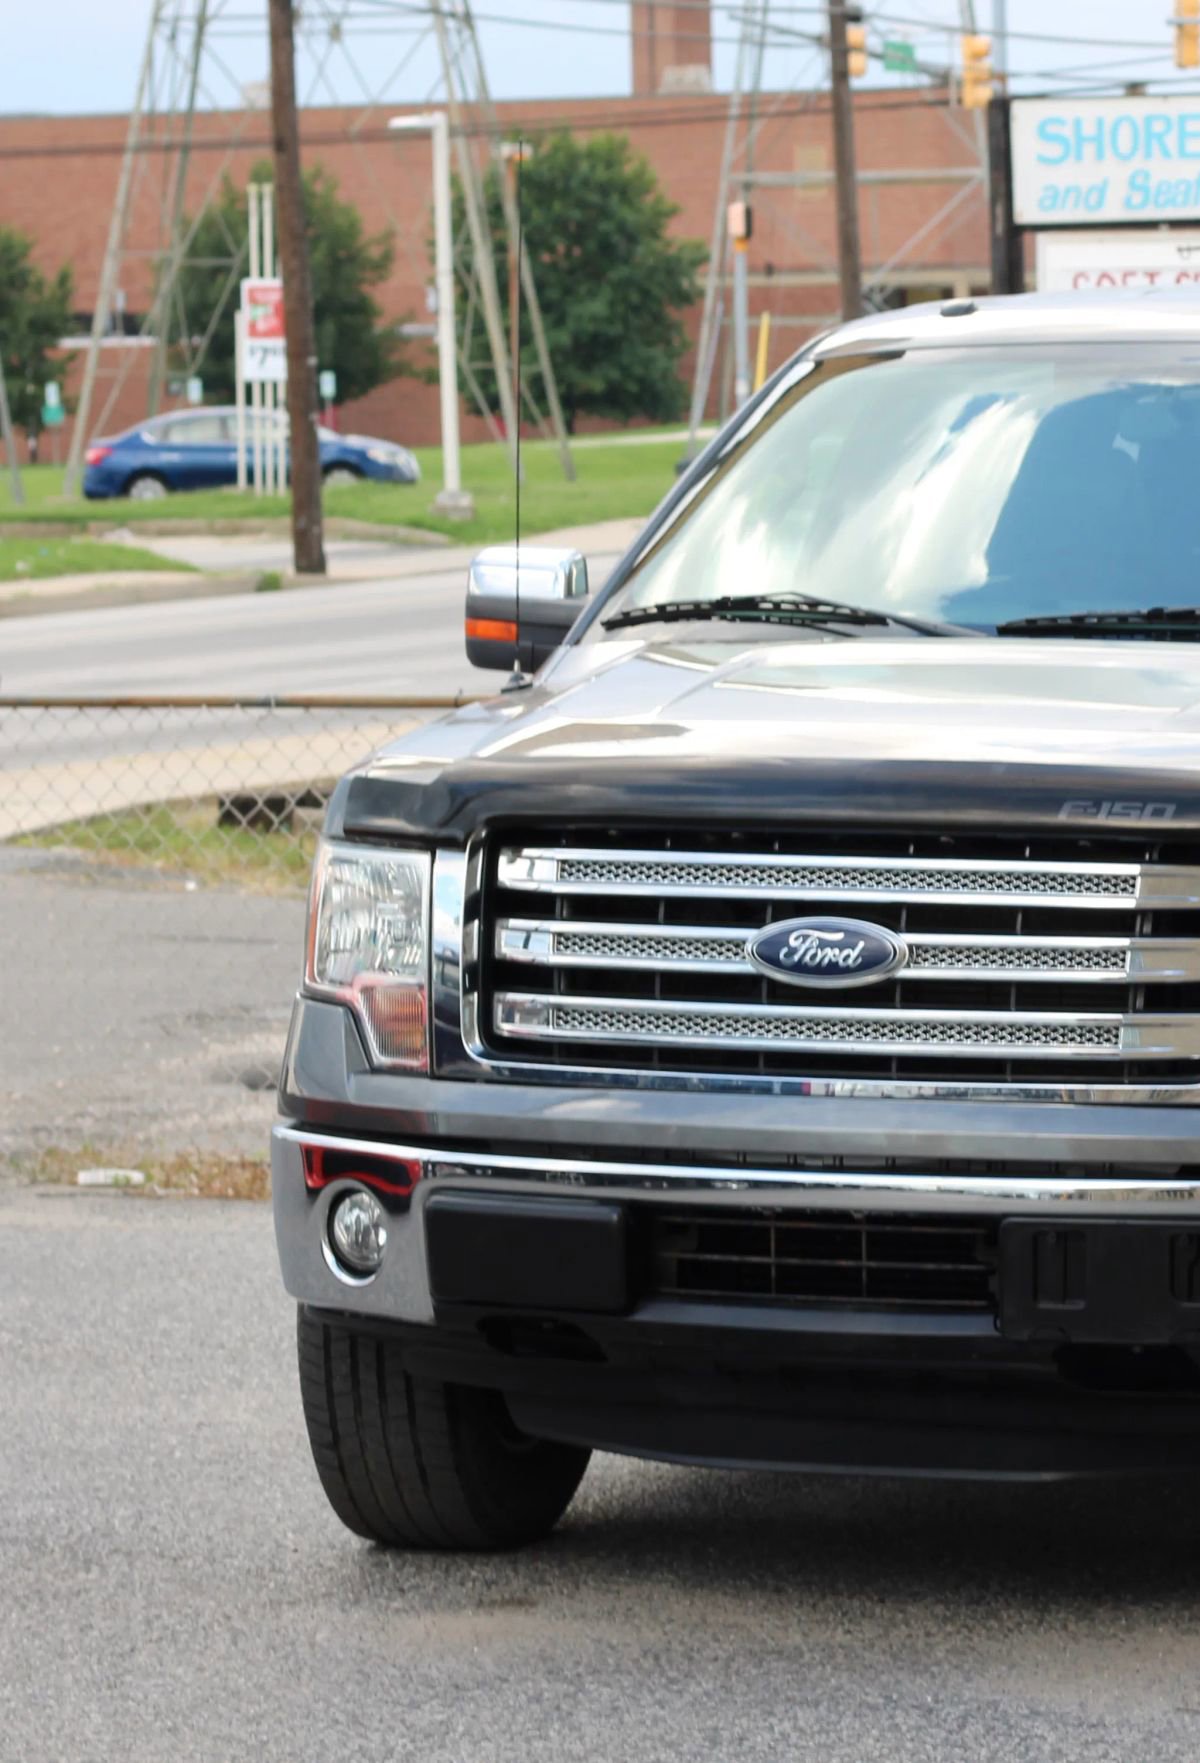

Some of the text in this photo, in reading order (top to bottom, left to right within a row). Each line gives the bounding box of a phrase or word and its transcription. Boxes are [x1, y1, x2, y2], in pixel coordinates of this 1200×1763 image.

[1038, 178, 1108, 213] and
[1058, 800, 1177, 821] F-150
[779, 928, 865, 967] Ford
